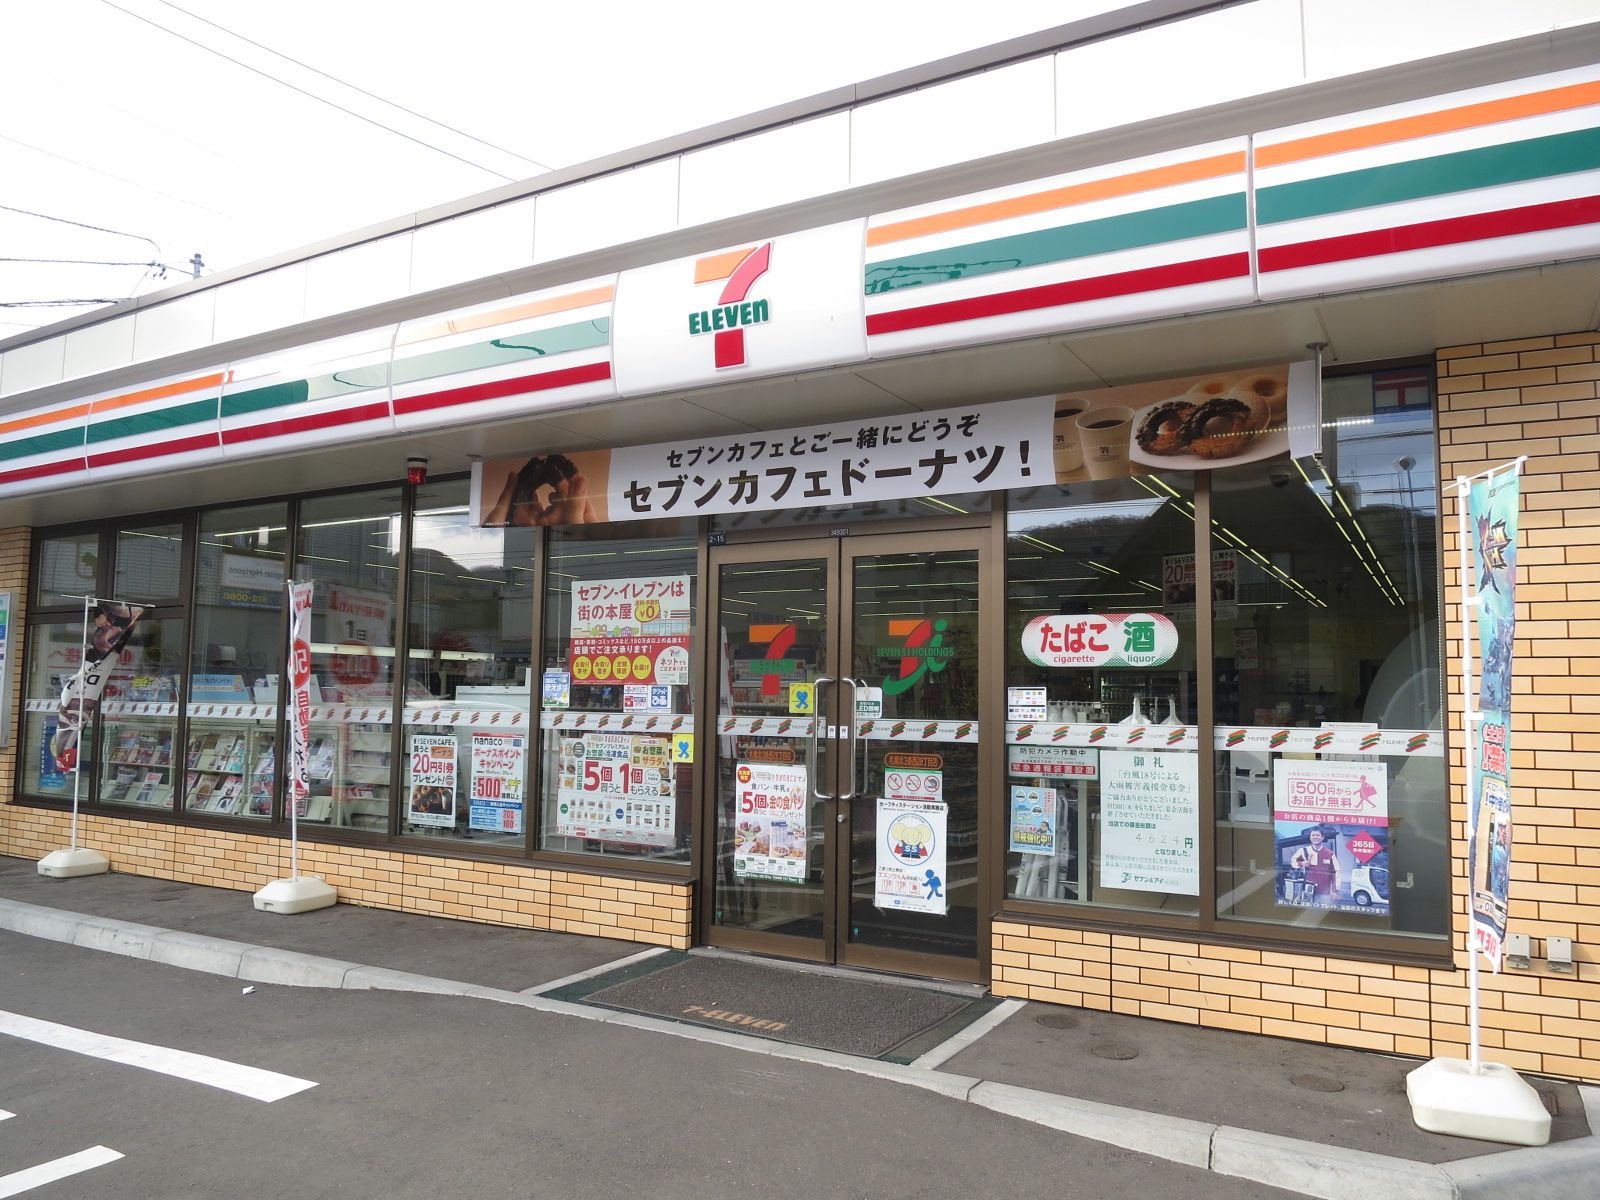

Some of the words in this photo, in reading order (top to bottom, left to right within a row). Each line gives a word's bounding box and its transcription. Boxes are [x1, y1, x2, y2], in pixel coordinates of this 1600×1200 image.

[688, 298, 769, 335] ELEVEN
[667, 414, 980, 468] セブンカフェとご一緒にどうぞ
[624, 440, 1031, 512] セブンカフェドーナツ!
[709, 536, 724, 544] 2-15
[578, 604, 632, 621] 街の本屋
[1040, 621, 1109, 652] たばこ
[1124, 621, 1155, 652] 酒
[1054, 655, 1095, 663] cigarette
[1127, 655, 1156, 663] liquor
[474, 738, 503, 746] nanaco
[474, 748, 521, 759] ボーナスポイント
[1020, 748, 1086, 756] 防犯カメラ作動中
[479, 760, 514, 770] キャンペーン
[413, 775, 445, 785] プレゼント!
[477, 777, 501, 798] 500
[600, 782, 621, 793] 買うと
[630, 785, 659, 796] もらえる
[1291, 796, 1352, 808] お届け無料
[1184, 837, 1193, 849] 円
[1352, 840, 1375, 848] 365日
[904, 845, 917, 853] SS
